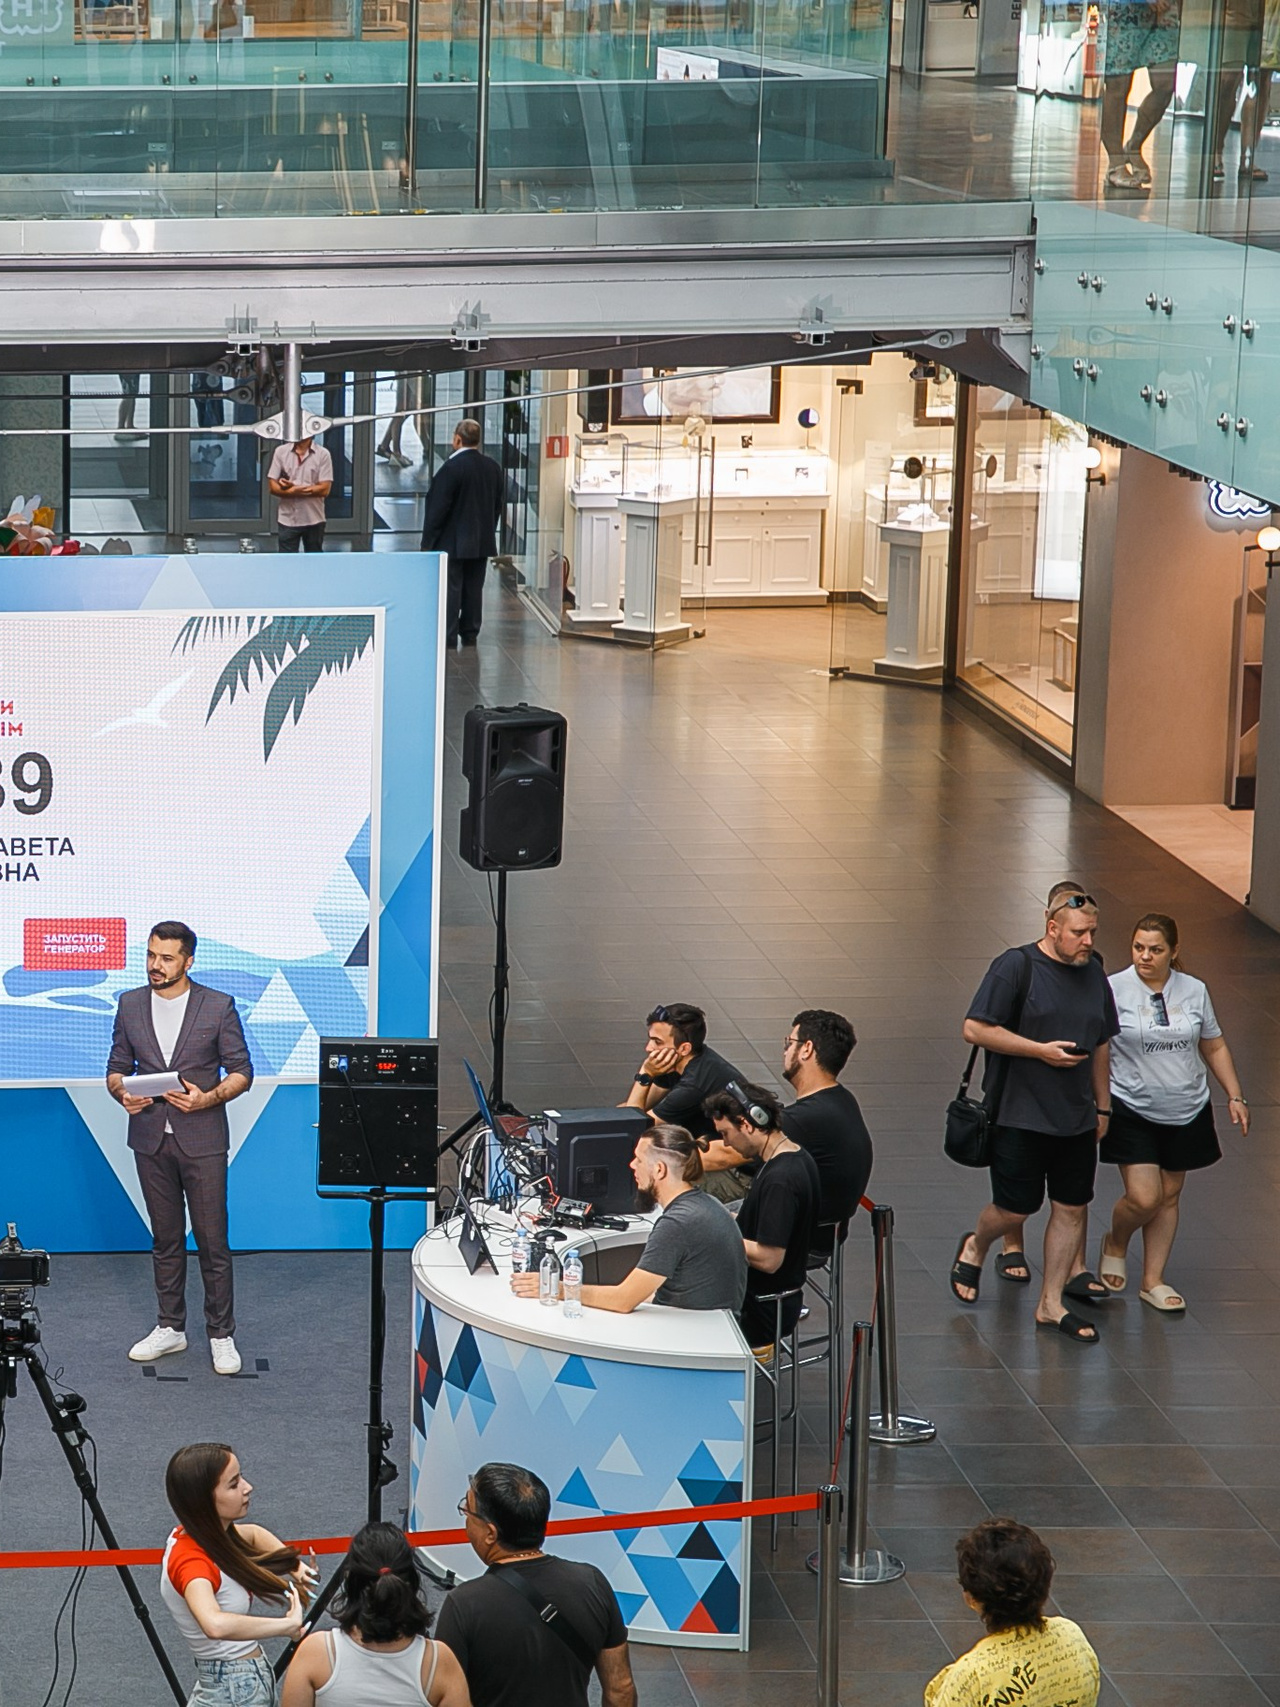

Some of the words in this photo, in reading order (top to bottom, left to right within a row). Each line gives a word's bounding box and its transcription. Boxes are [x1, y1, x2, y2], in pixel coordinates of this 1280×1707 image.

[1011, 0, 1022, 20] RE
[44, 934, 106, 943] ЗАПУСТИТЬ
[44, 945, 105, 953] ГЕНЕРАТОР
